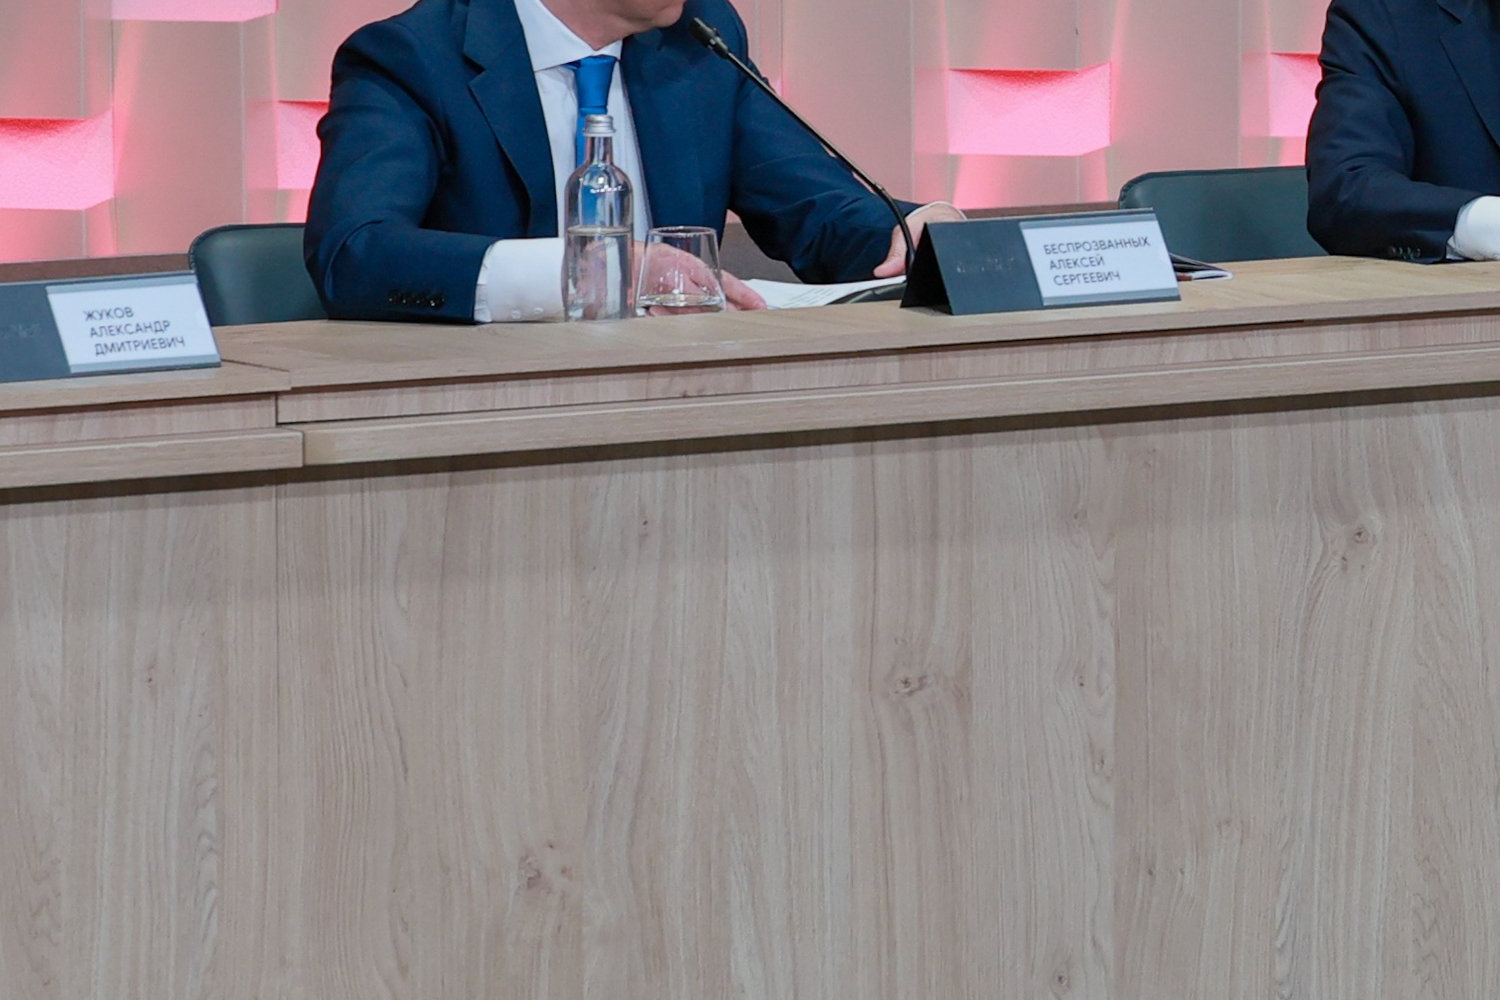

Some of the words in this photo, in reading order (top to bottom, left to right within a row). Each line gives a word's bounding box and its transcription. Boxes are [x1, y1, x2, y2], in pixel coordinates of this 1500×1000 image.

[1043, 236, 1150, 255] БЕСПРОЗВАННЫХ
[1049, 253, 1105, 270] АЛЕКСЕЙ
[1053, 270, 1121, 286] СЕРГЕЕВИЧ
[83, 306, 134, 322] ЖУКОВ
[90, 320, 171, 338] АЛЕКСАНДР
[94, 336, 186, 356] ДМИТРИЕВИЧ
